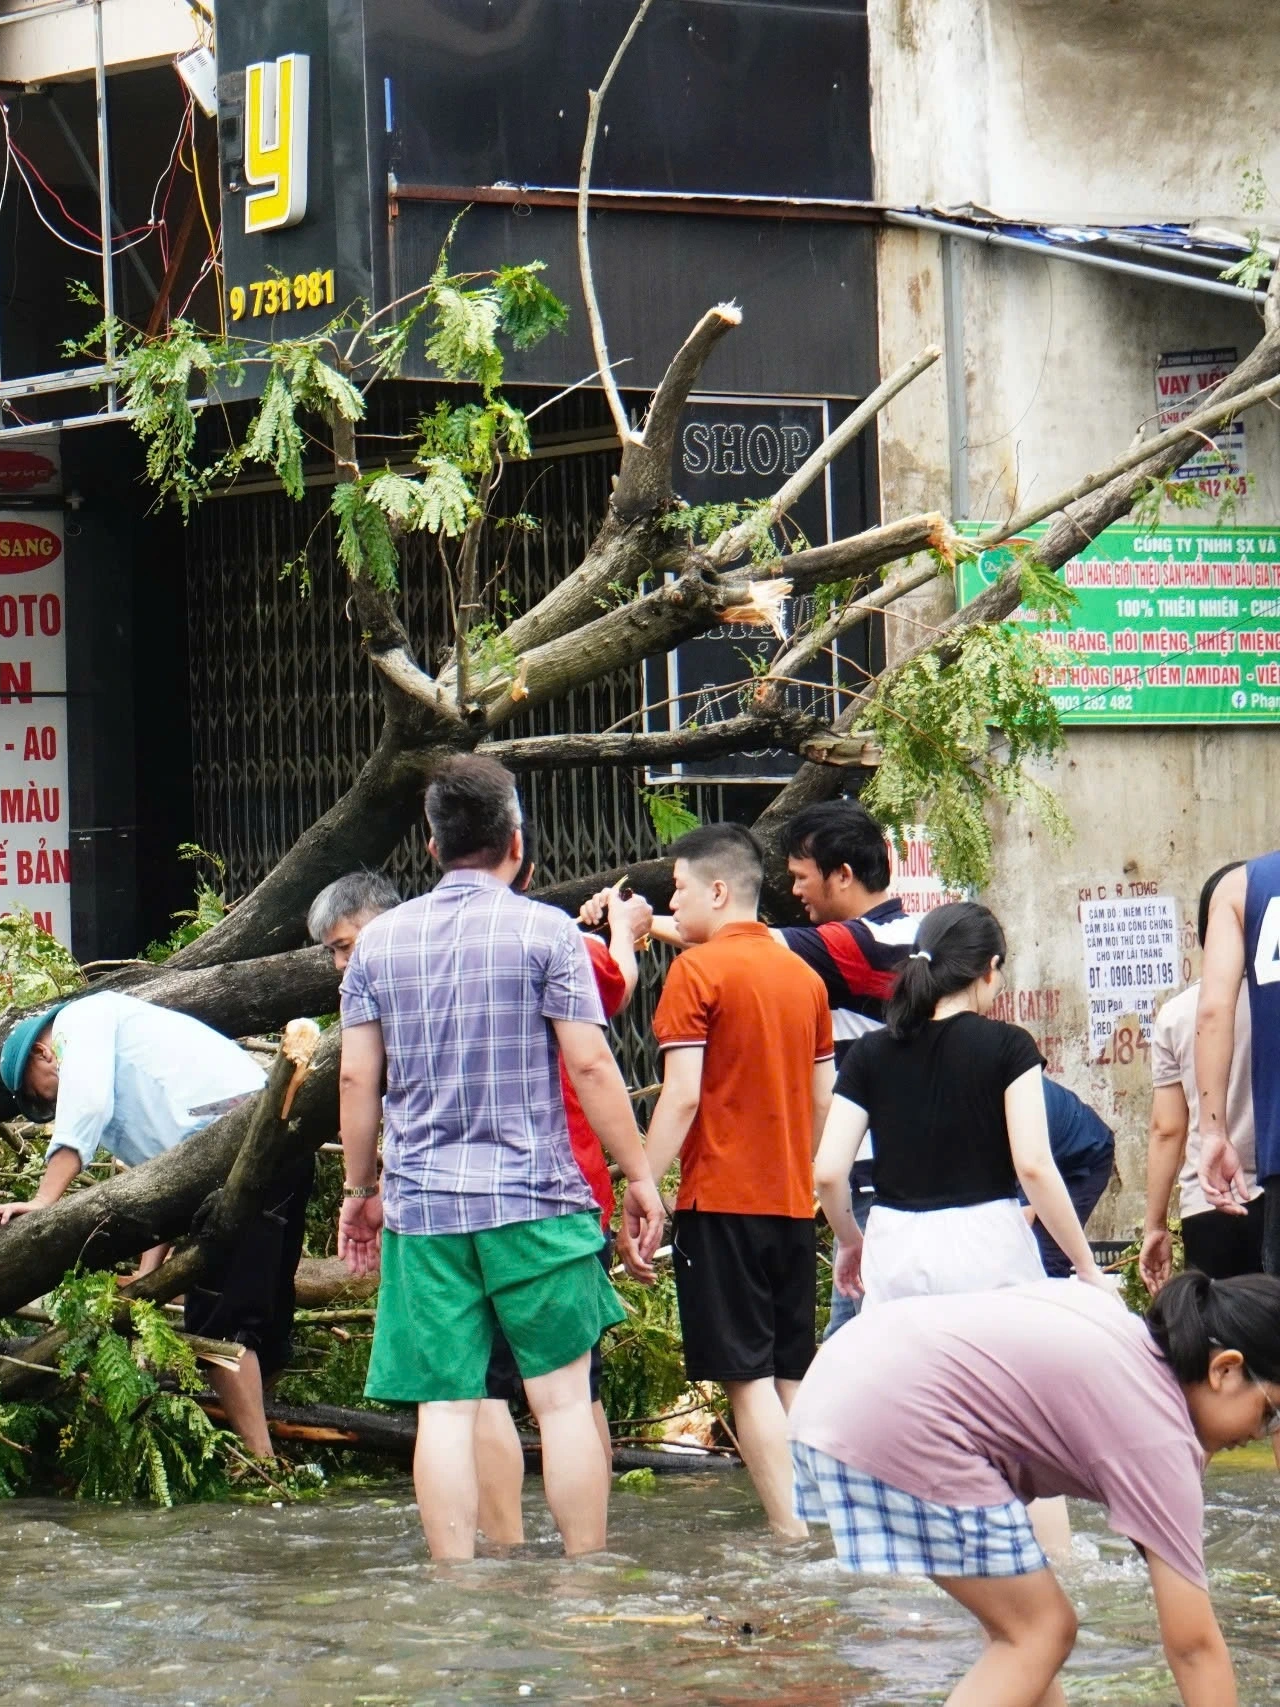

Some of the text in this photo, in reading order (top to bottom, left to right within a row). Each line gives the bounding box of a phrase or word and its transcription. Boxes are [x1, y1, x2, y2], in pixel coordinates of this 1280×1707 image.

[1158, 375, 1191, 397] VAY
[683, 423, 811, 475] SHOP
[0, 538, 54, 557] SANG
[1176, 538, 1192, 553] TY
[1196, 537, 1232, 553] TNHH
[1236, 538, 1255, 553] SX
[1259, 536, 1276, 553] VÀ
[1134, 557, 1161, 592] THIỆU
[1163, 554, 1182, 587] SẢN
[1211, 562, 1233, 587] TINH
[1254, 562, 1271, 587] GIA
[1116, 599, 1154, 618] 100%
[1113, 628, 1138, 653] HÔI
[1140, 628, 1192, 656] MIỆNG,
[1195, 628, 1236, 656] NHIỆT
[1112, 666, 1142, 690] HẠT,
[1145, 663, 1181, 687] VIÊM
[1184, 665, 1241, 687] AMIDAN
[1084, 695, 1106, 710] 282
[1110, 695, 1133, 710] 482
[0, 780, 60, 824] MÀU
[16, 838, 72, 885] BẢN
[1112, 949, 1125, 960] VAY
[1110, 963, 1174, 988] 0906.059.195
